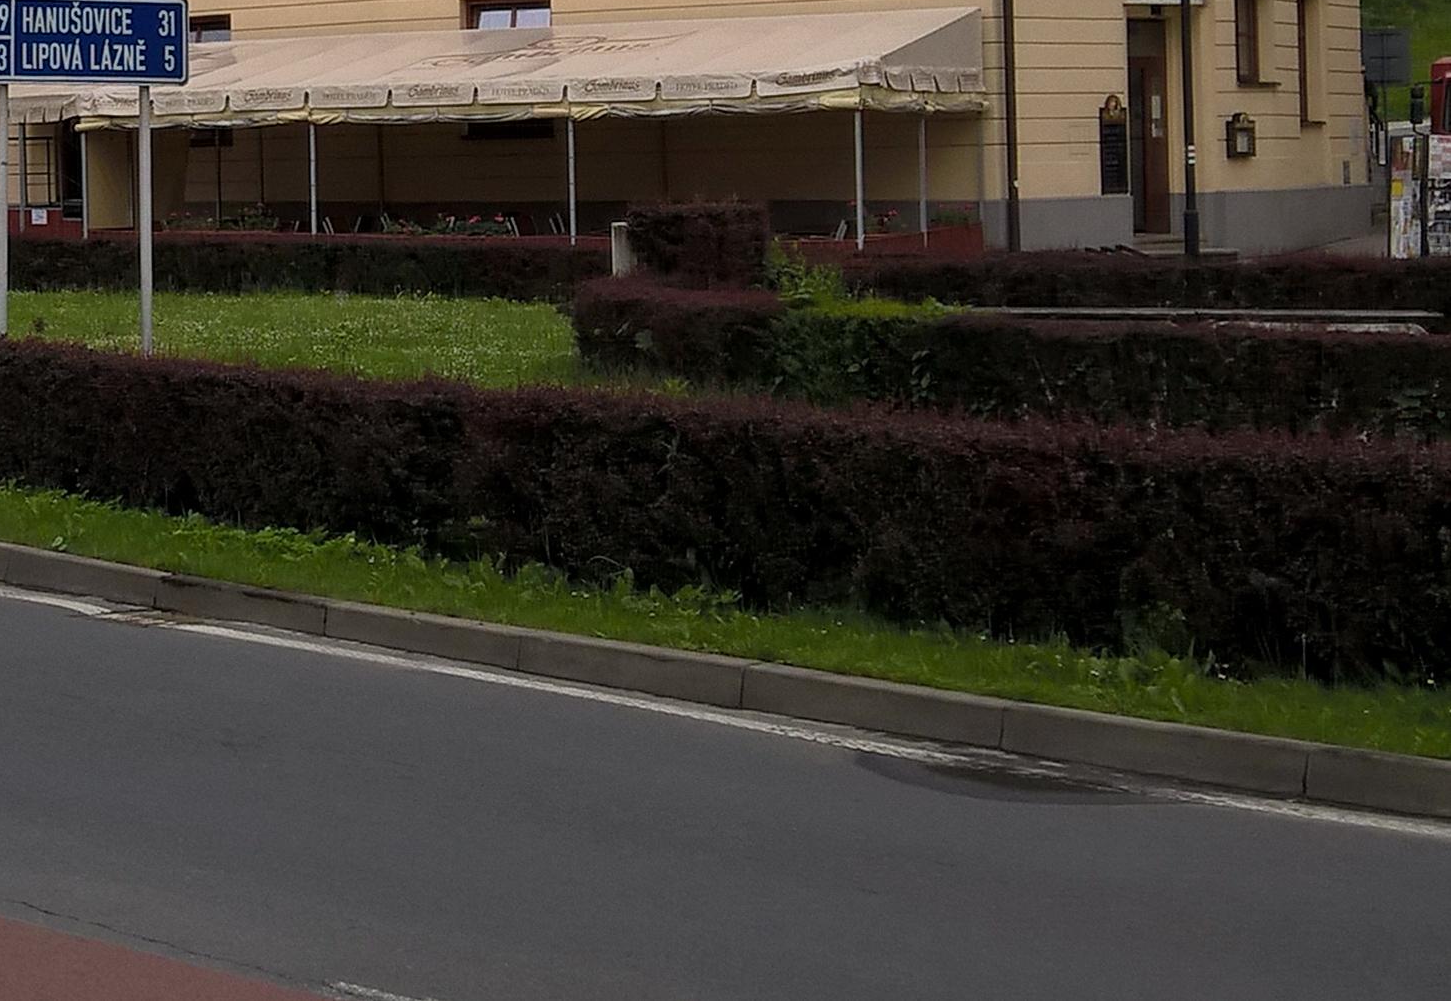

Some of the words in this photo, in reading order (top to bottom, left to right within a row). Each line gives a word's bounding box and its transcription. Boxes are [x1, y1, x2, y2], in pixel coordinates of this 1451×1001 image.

[22, 2, 133, 36] HANUŠOVICE
[158, 10, 176, 37] 31
[22, 39, 83, 70] LIPOVÁ
[90, 39, 147, 72] LÁZNĚ
[164, 46, 175, 72] 5
[584, 79, 640, 93] Gambrinus
[775, 70, 837, 87] Gambrinus
[407, 84, 461, 98] Gambrinus
